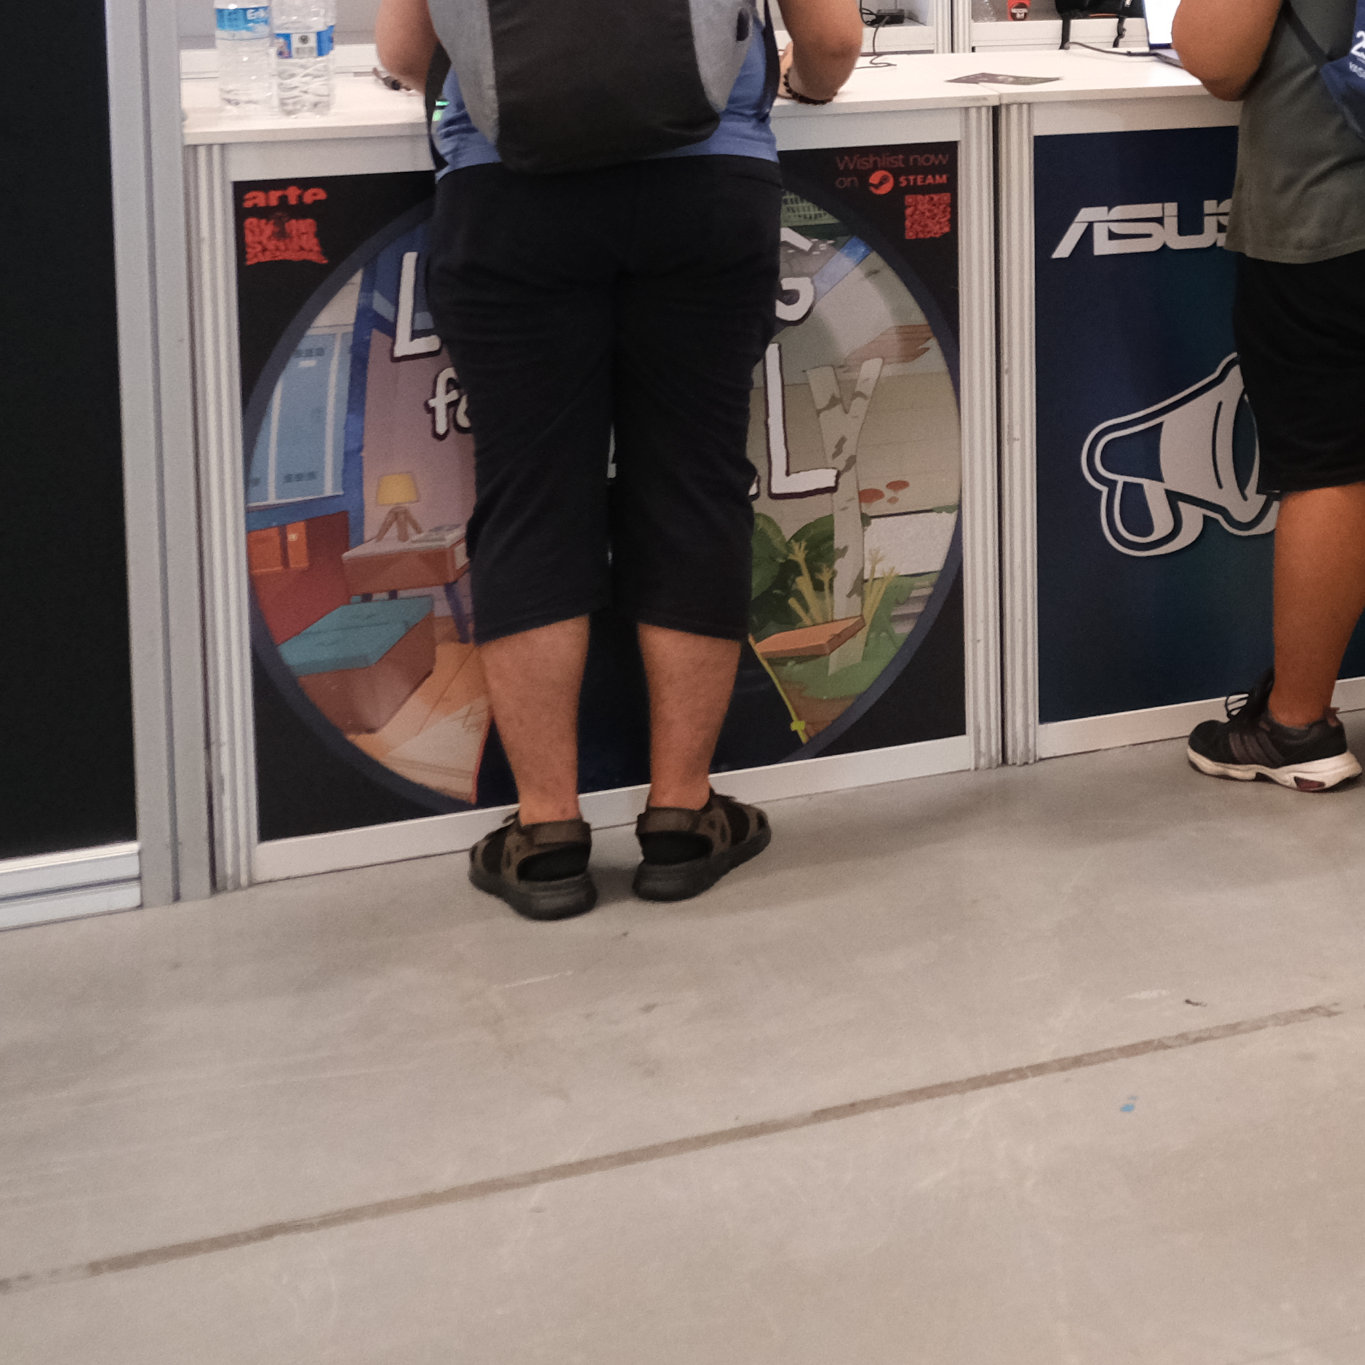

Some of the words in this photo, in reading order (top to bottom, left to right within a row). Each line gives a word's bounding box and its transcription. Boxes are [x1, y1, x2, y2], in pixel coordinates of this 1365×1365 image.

[836, 153, 905, 170] Wishlist
[909, 154, 949, 166] now
[835, 176, 859, 188] on
[899, 174, 949, 187] STEAM
[1051, 197, 1232, 259] ASU
